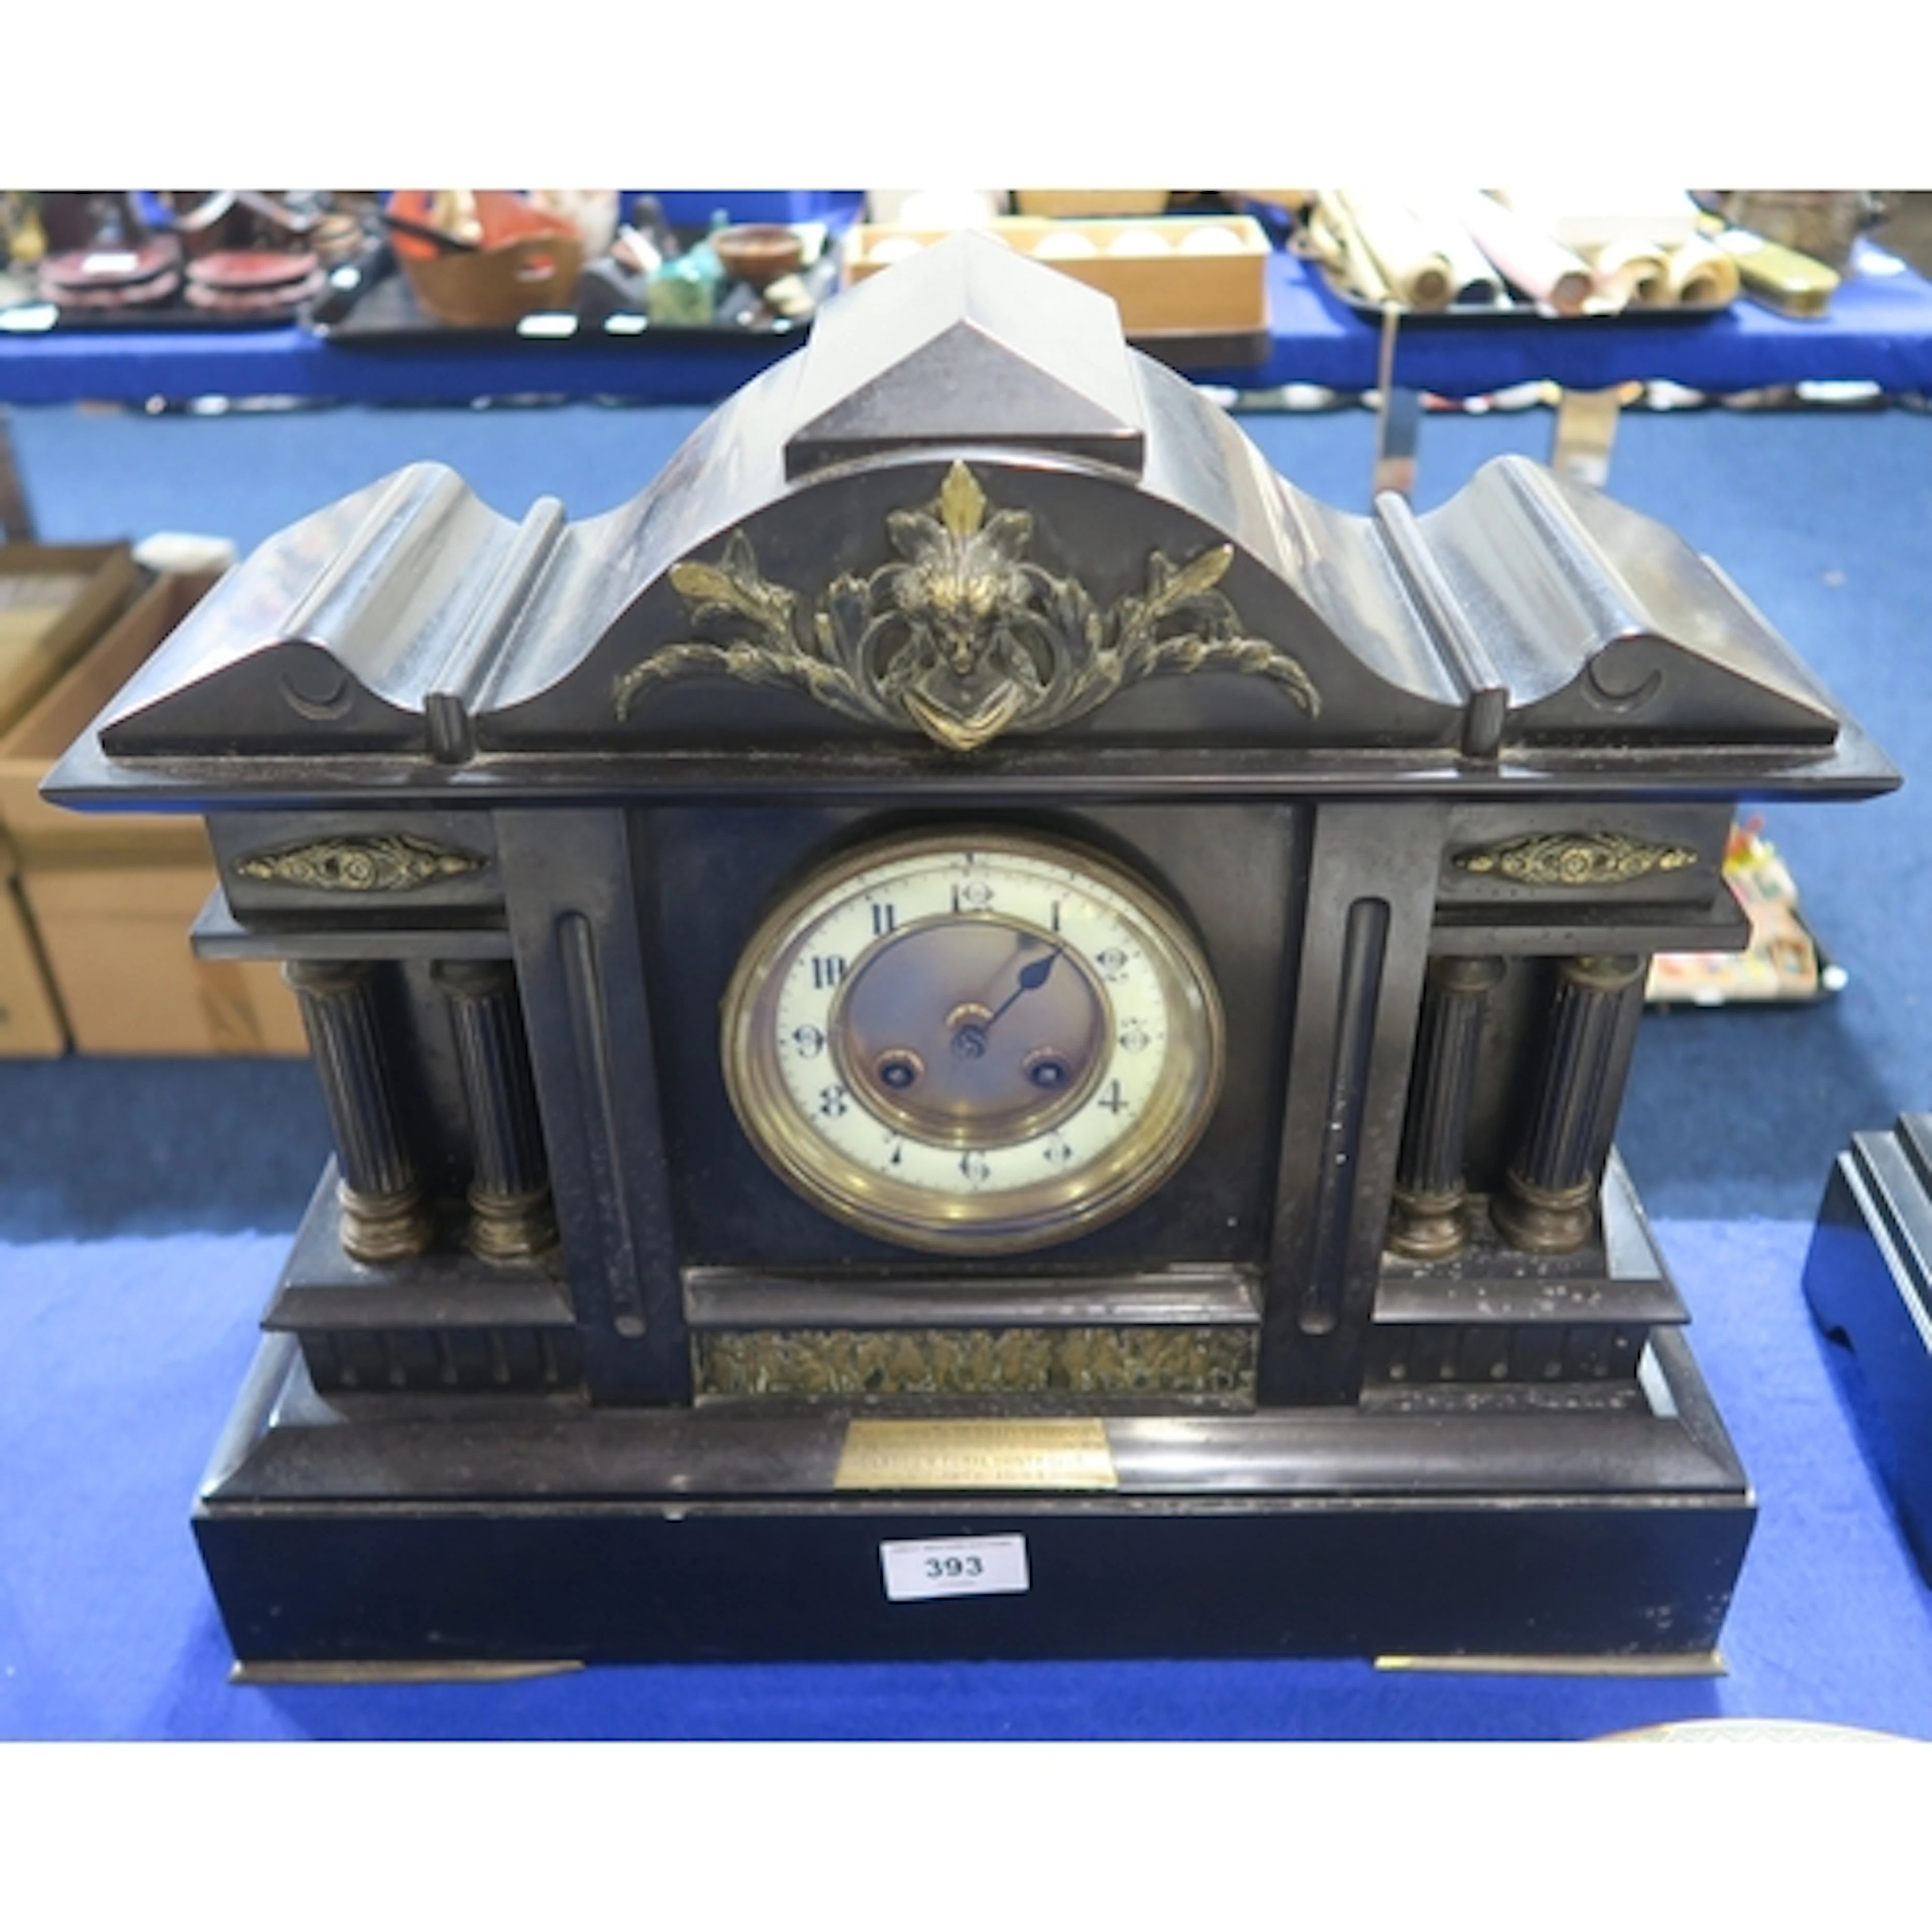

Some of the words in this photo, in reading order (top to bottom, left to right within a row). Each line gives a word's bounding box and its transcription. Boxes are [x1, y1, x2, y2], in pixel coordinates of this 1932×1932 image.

[792, 1023, 825, 1059] 9
[820, 1084, 848, 1118] 8
[1097, 1078, 1129, 1115] 4
[958, 1150, 991, 1183] 6
[924, 1556, 985, 1578] 393
